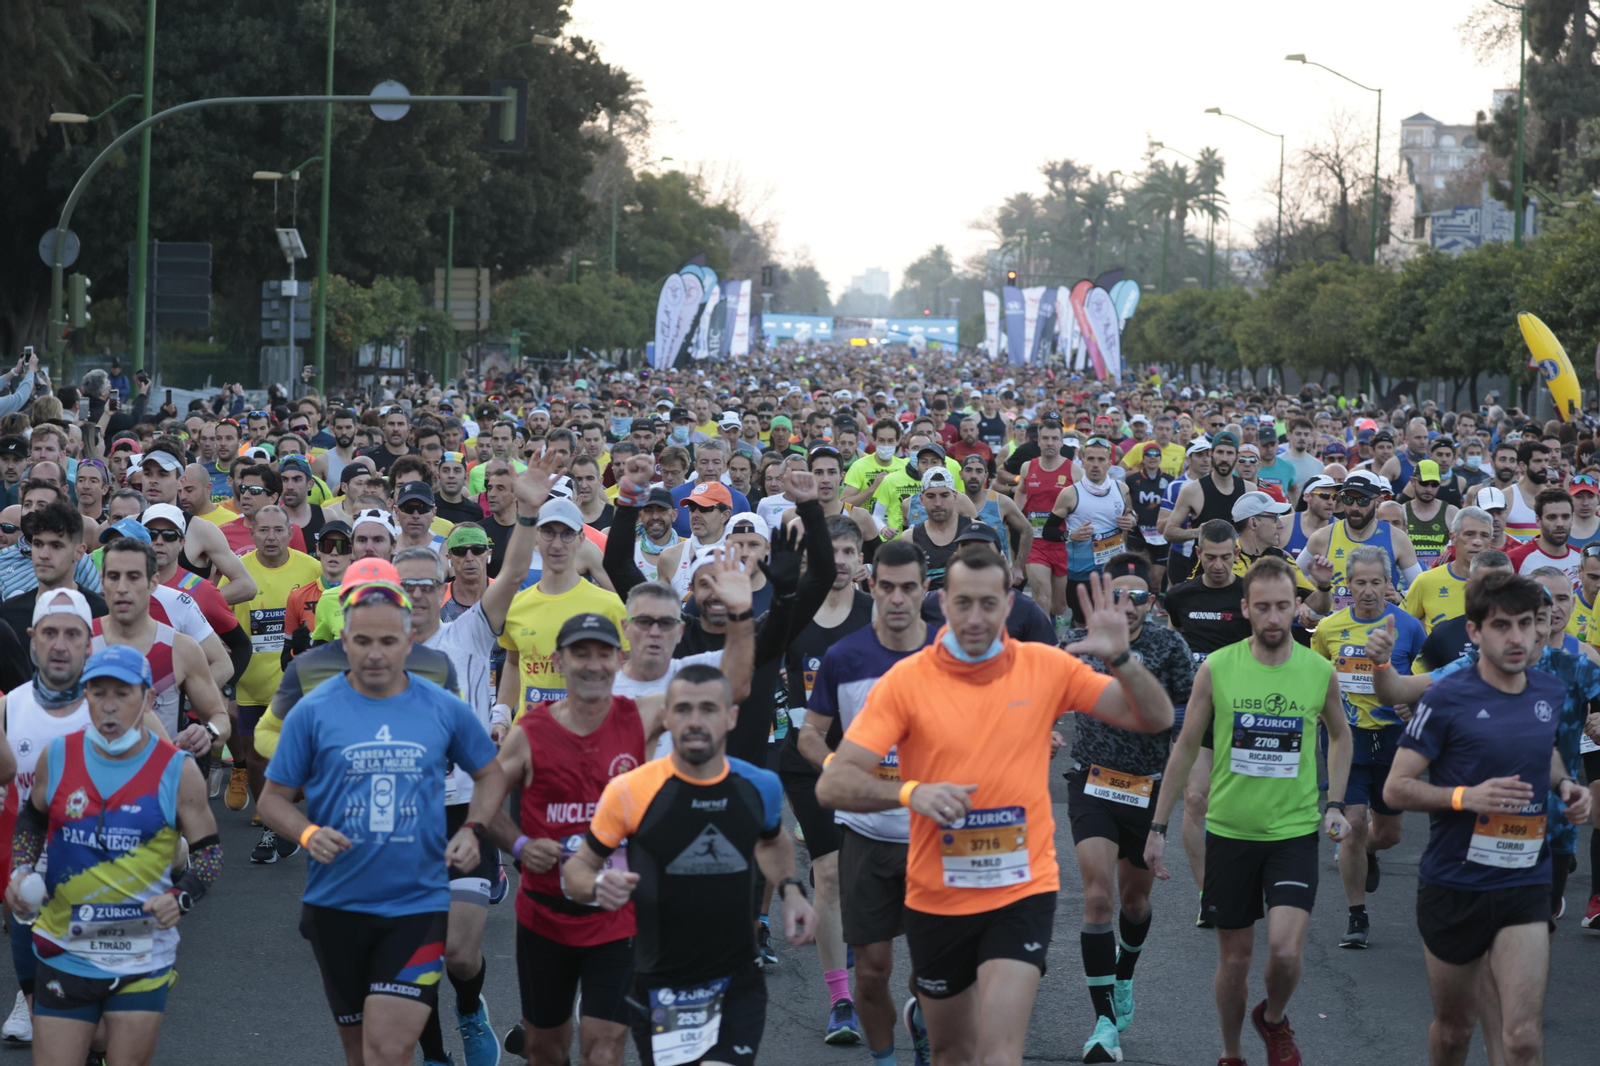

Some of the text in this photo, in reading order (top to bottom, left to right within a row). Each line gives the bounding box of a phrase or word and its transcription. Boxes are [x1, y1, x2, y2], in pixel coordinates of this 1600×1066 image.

[709, 328, 721, 359] ABC
[266, 623, 283, 632] 2307
[1354, 663, 1372, 671] 4427
[1256, 717, 1296, 729] ZURICH
[375, 724, 392, 743] 4
[1254, 736, 1280, 749] 2709
[345, 748, 424, 761] CARRERA ROSA
[1248, 752, 1283, 762] RICARDO
[352, 758, 416, 769] DE LA MUJER
[1109, 777, 1131, 789] 3553
[1094, 787, 1140, 805] LUIS SANTOS
[967, 810, 1016, 826] ZURICH
[1501, 823, 1527, 835] 3499
[62, 826, 140, 851] PALACIEGO
[970, 838, 1000, 851] 3716
[1496, 841, 1525, 851] CURRO
[970, 857, 1002, 868] PABLO
[96, 907, 142, 919] ZURICH
